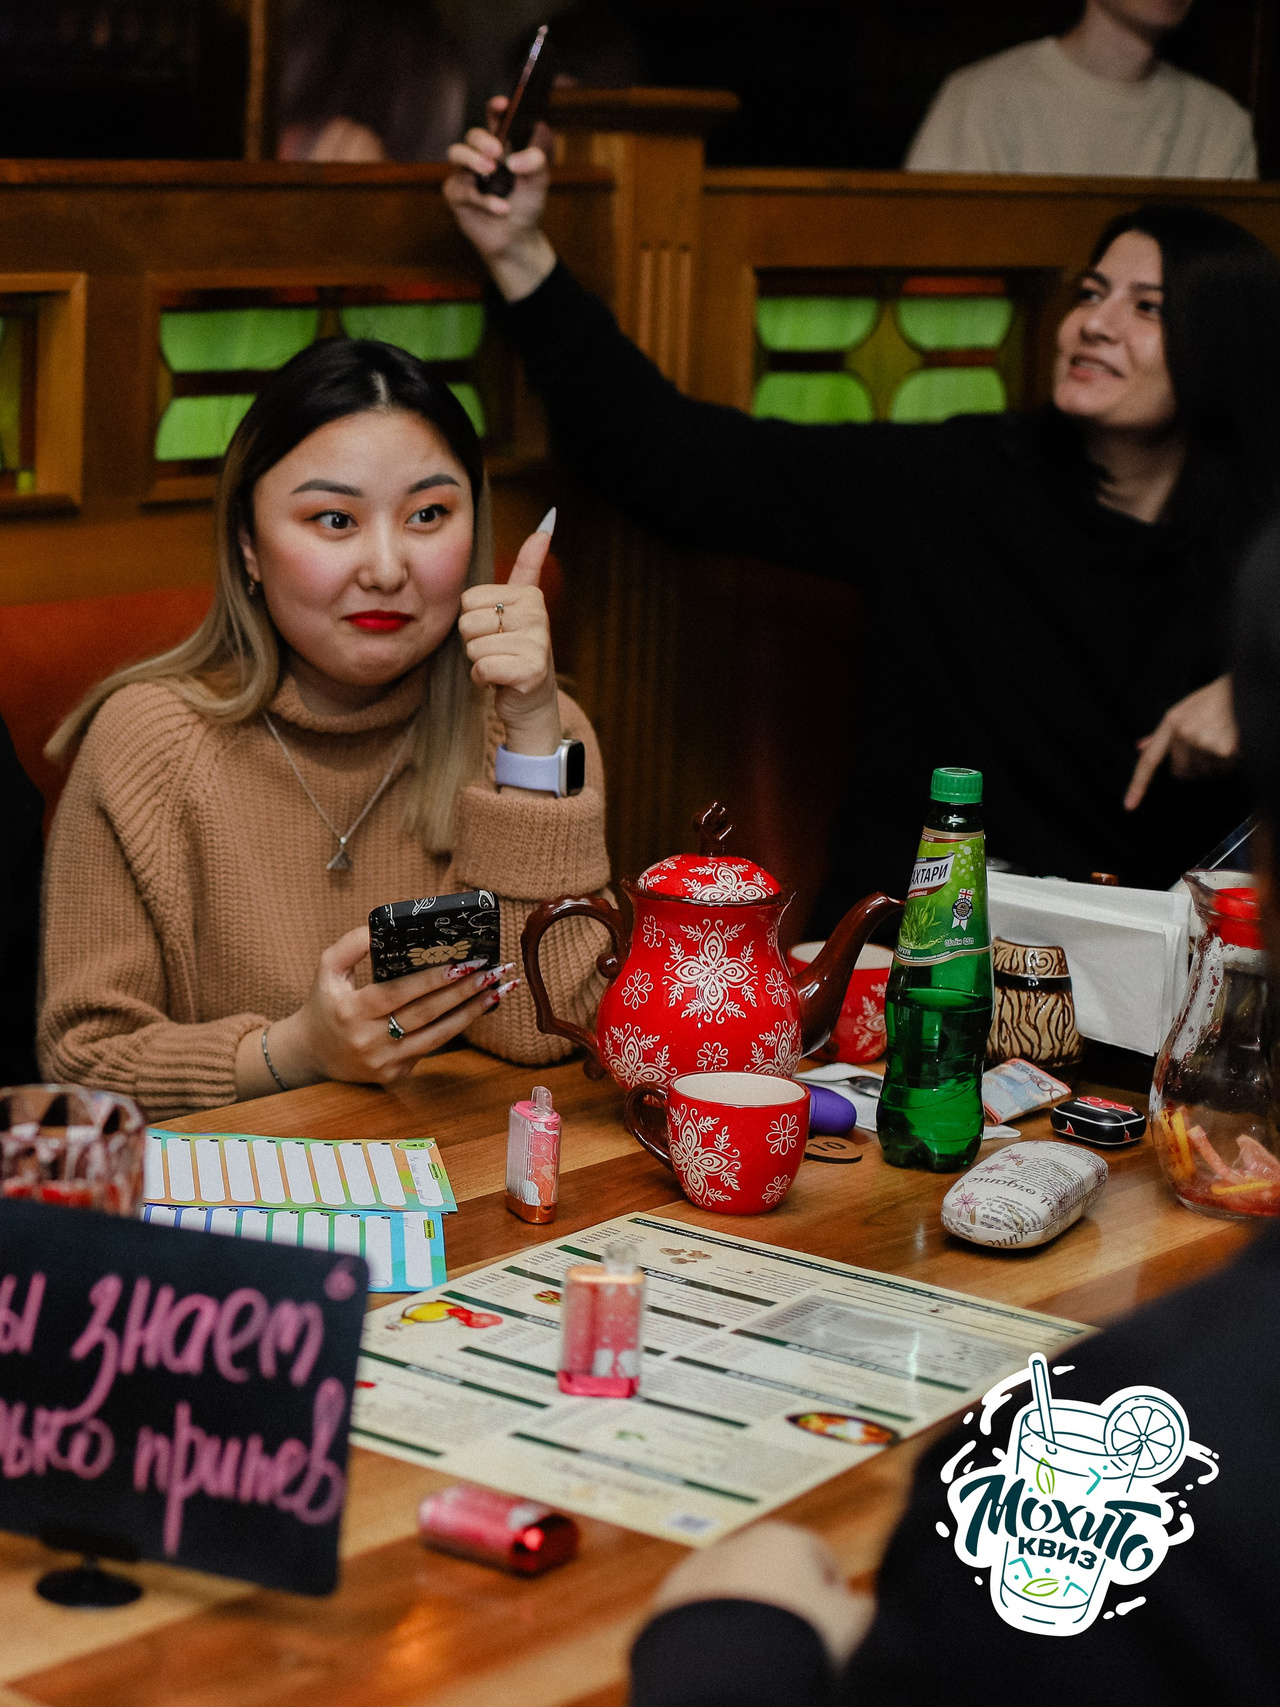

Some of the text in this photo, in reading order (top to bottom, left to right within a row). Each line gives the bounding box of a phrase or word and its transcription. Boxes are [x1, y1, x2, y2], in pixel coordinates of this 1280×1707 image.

[807, 1141, 847, 1152] 10
[968, 1177, 1036, 1195] organic
[70, 1271, 325, 1425] знаем
